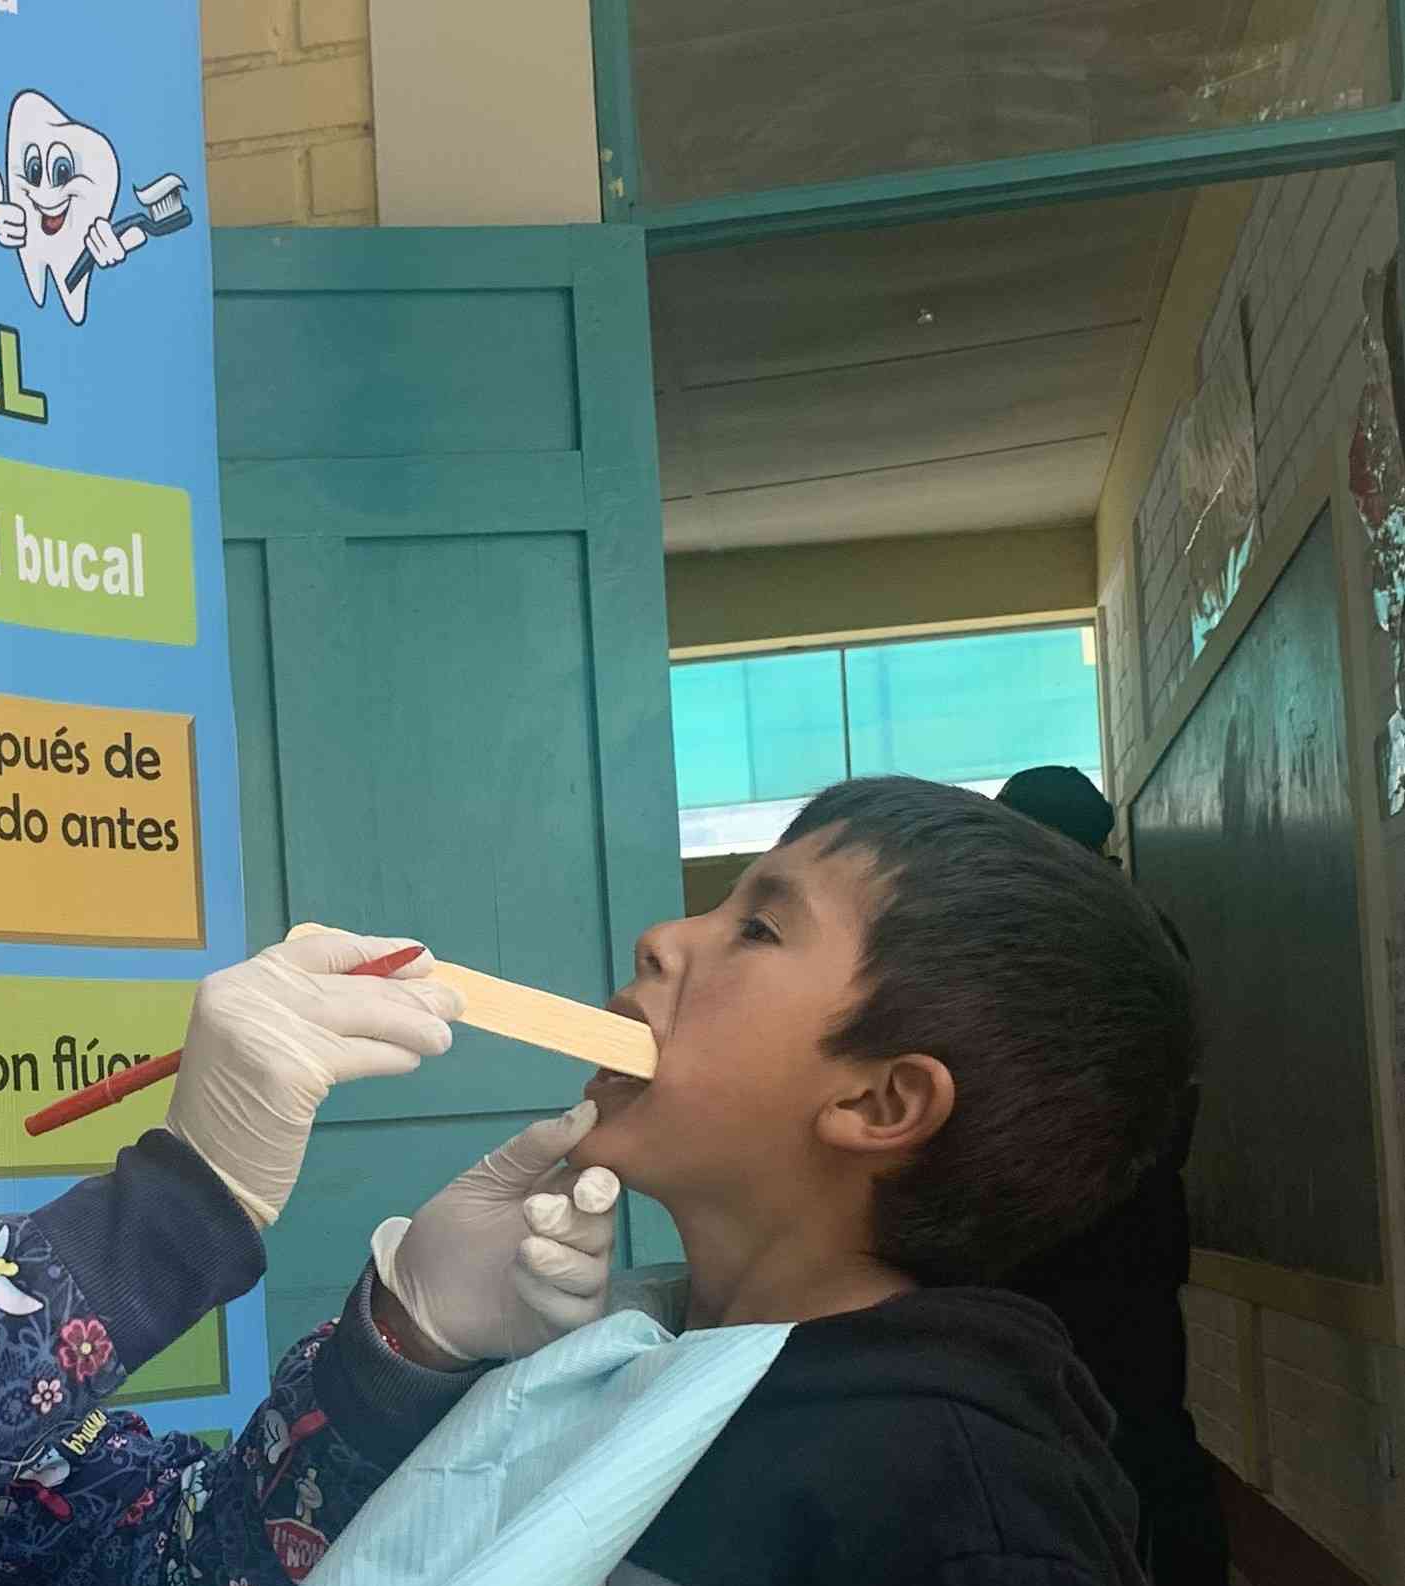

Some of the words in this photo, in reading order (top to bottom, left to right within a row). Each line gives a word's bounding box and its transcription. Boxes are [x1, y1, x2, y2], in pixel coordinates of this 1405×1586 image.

[16, 514, 145, 597] bucal
[104, 732, 162, 781] de
[62, 807, 179, 852] antes
